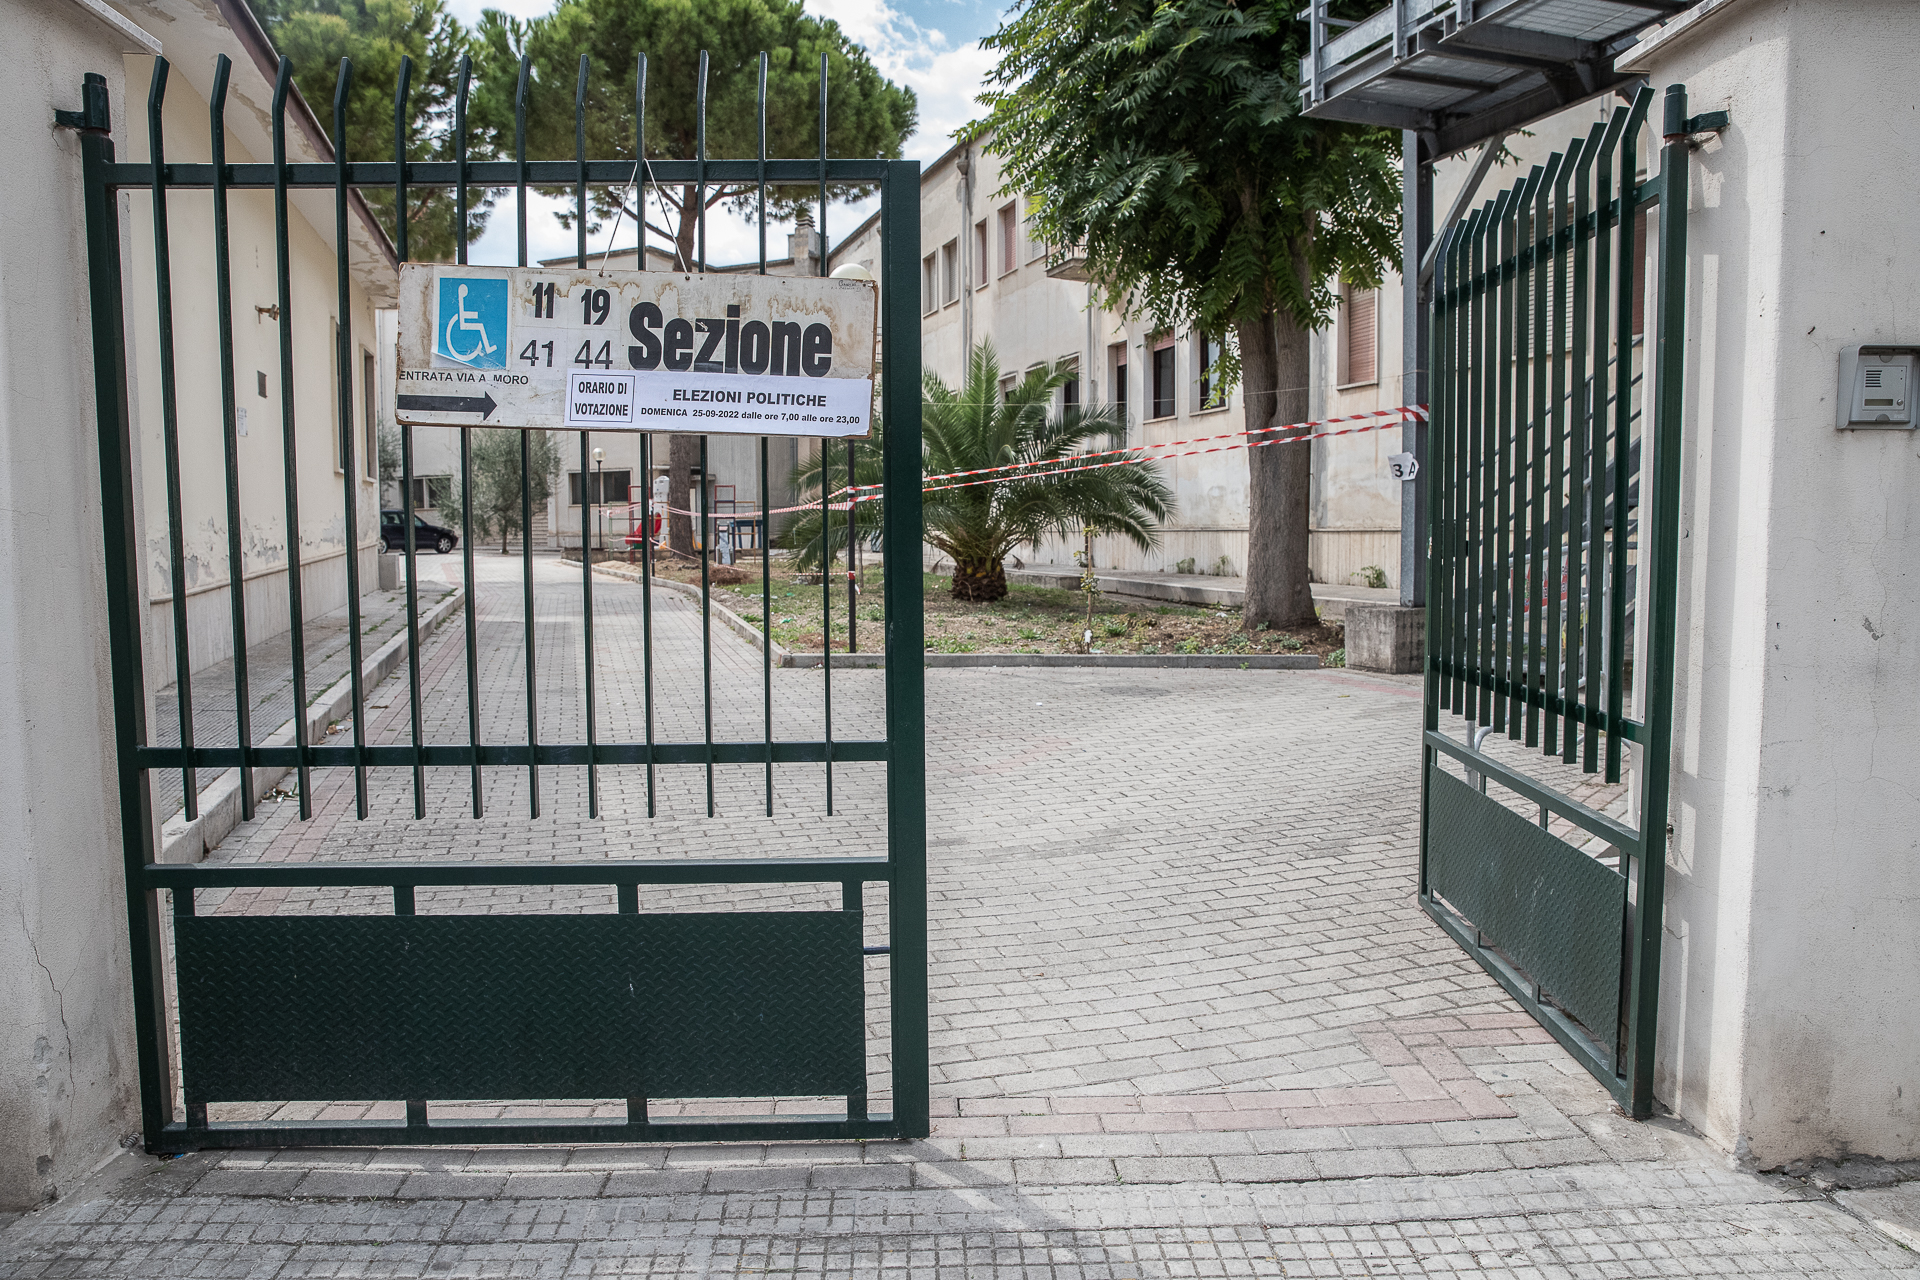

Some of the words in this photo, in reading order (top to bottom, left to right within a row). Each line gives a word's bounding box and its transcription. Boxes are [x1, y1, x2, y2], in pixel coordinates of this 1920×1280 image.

[532, 282, 555, 319] 11
[581, 288, 611, 326] 19
[628, 301, 833, 378] Sezione
[520, 339, 554, 368] 41
[574, 339, 613, 370] 44
[398, 370, 453, 382] ENTRATA
[456, 373, 476, 383] VIA
[493, 374, 529, 385] MORO
[578, 381, 615, 395] ORARIO
[617, 382, 628, 395] DI
[672, 388, 742, 403] ELEZIONI
[746, 391, 827, 407] POLITICHE
[574, 402, 629, 416] VOTAZIONE
[640, 407, 688, 417] DOMENICA
[692, 409, 739, 419] 25-09-2022
[741, 411, 762, 420] dalle
[764, 413, 779, 421] ore
[781, 412, 800, 422] 7,00
[801, 414, 818, 422] alle
[819, 415, 834, 423] ore
[836, 415, 860, 425] 23,00
[1392, 463, 1404, 478] 3
